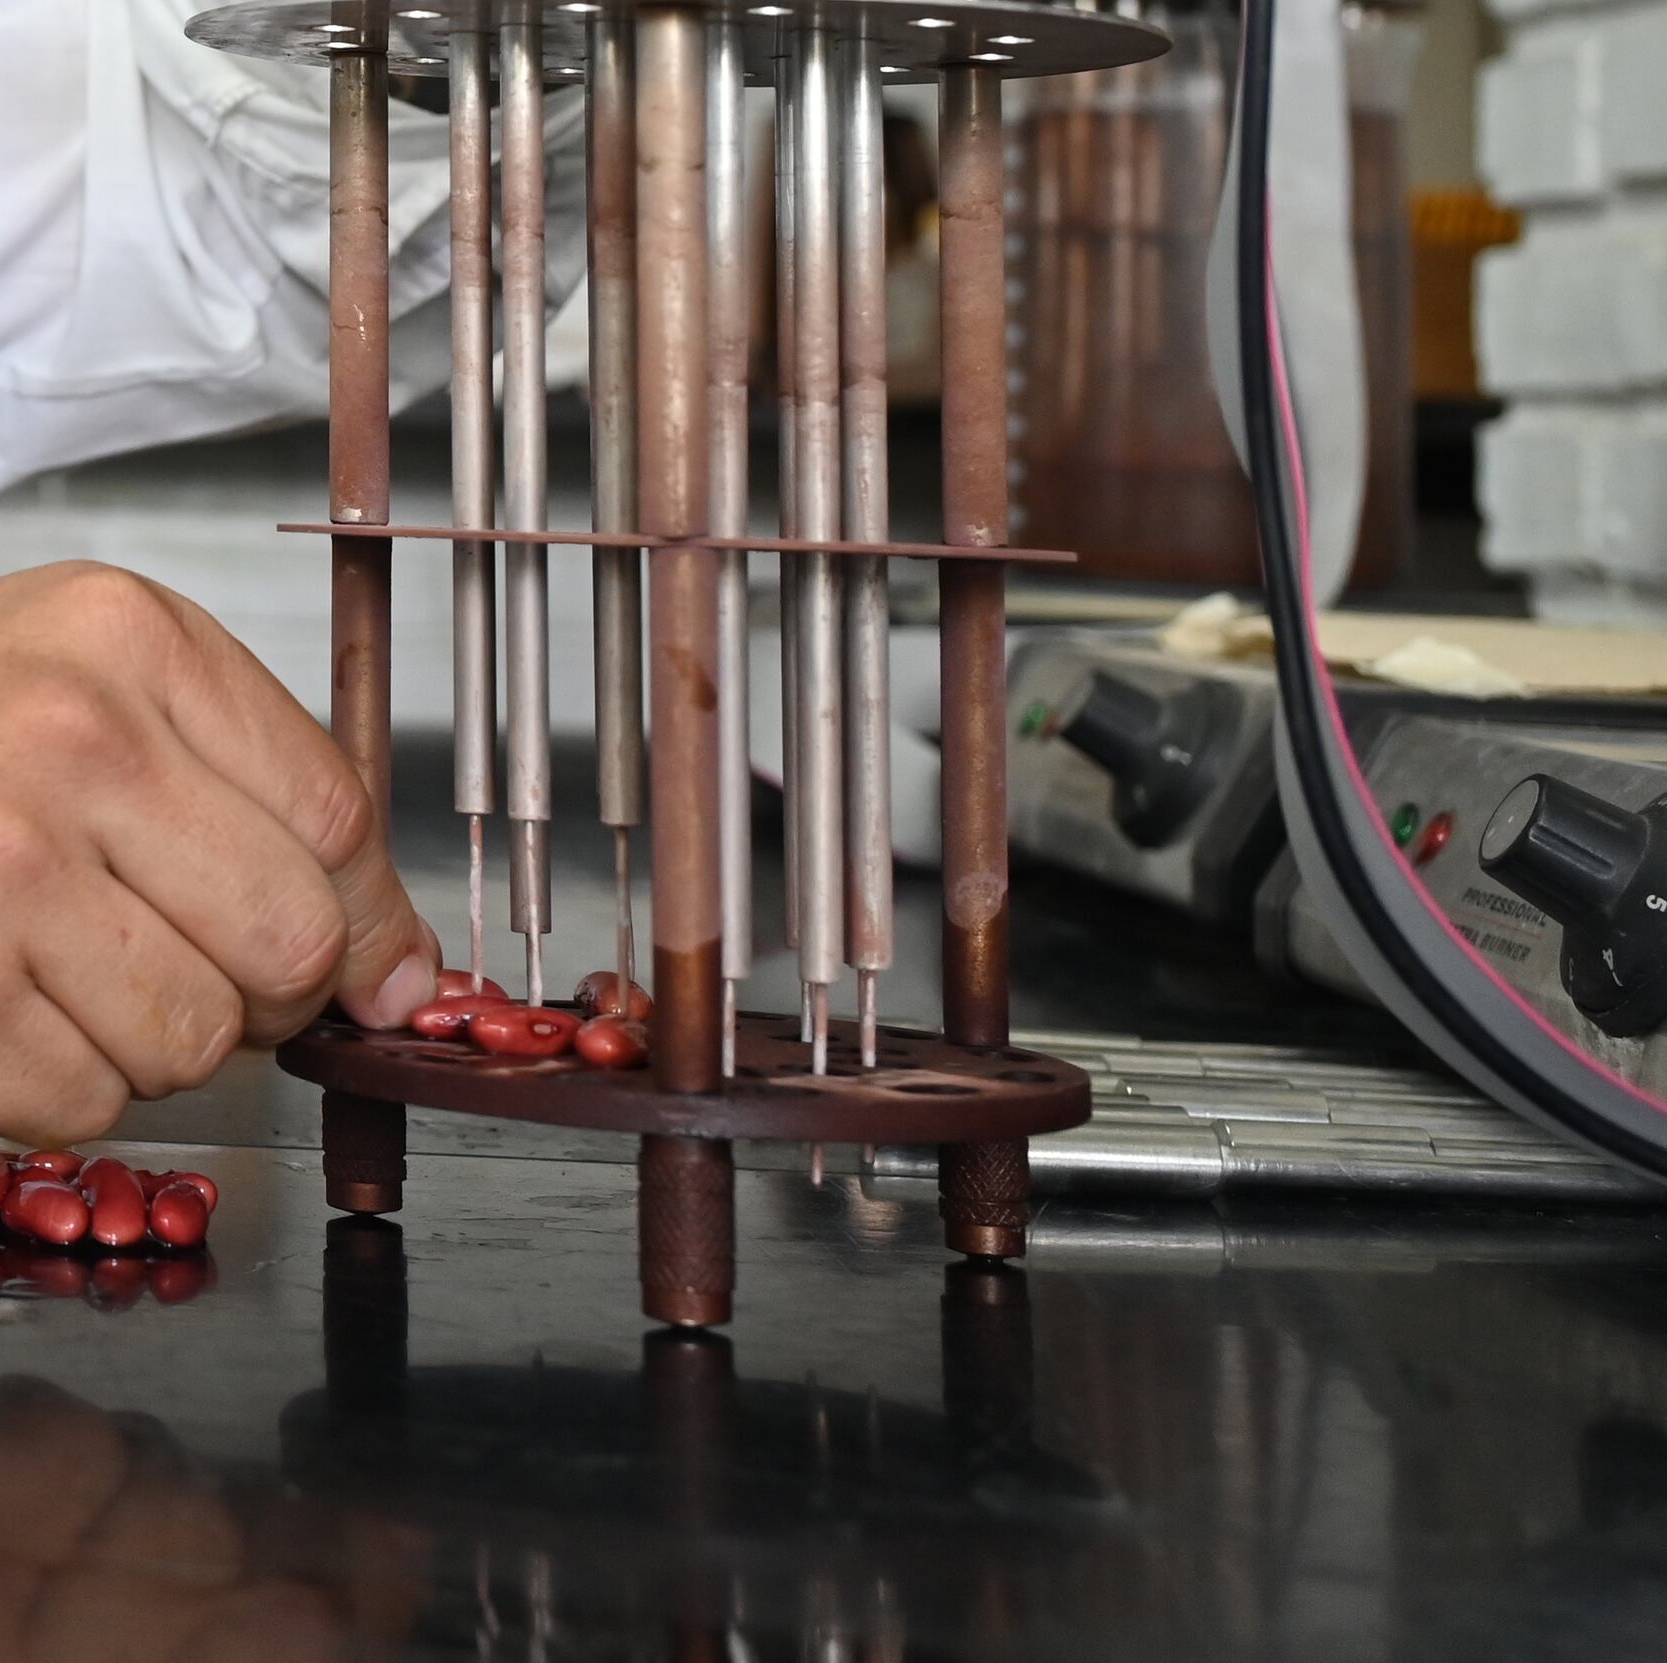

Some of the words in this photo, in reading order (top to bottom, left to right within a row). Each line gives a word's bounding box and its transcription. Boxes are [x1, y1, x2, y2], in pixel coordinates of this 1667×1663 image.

[1461, 887, 1547, 928] PROFESSIONAL
[1646, 894, 1667, 913] 5
[1479, 932, 1532, 963] BURNER
